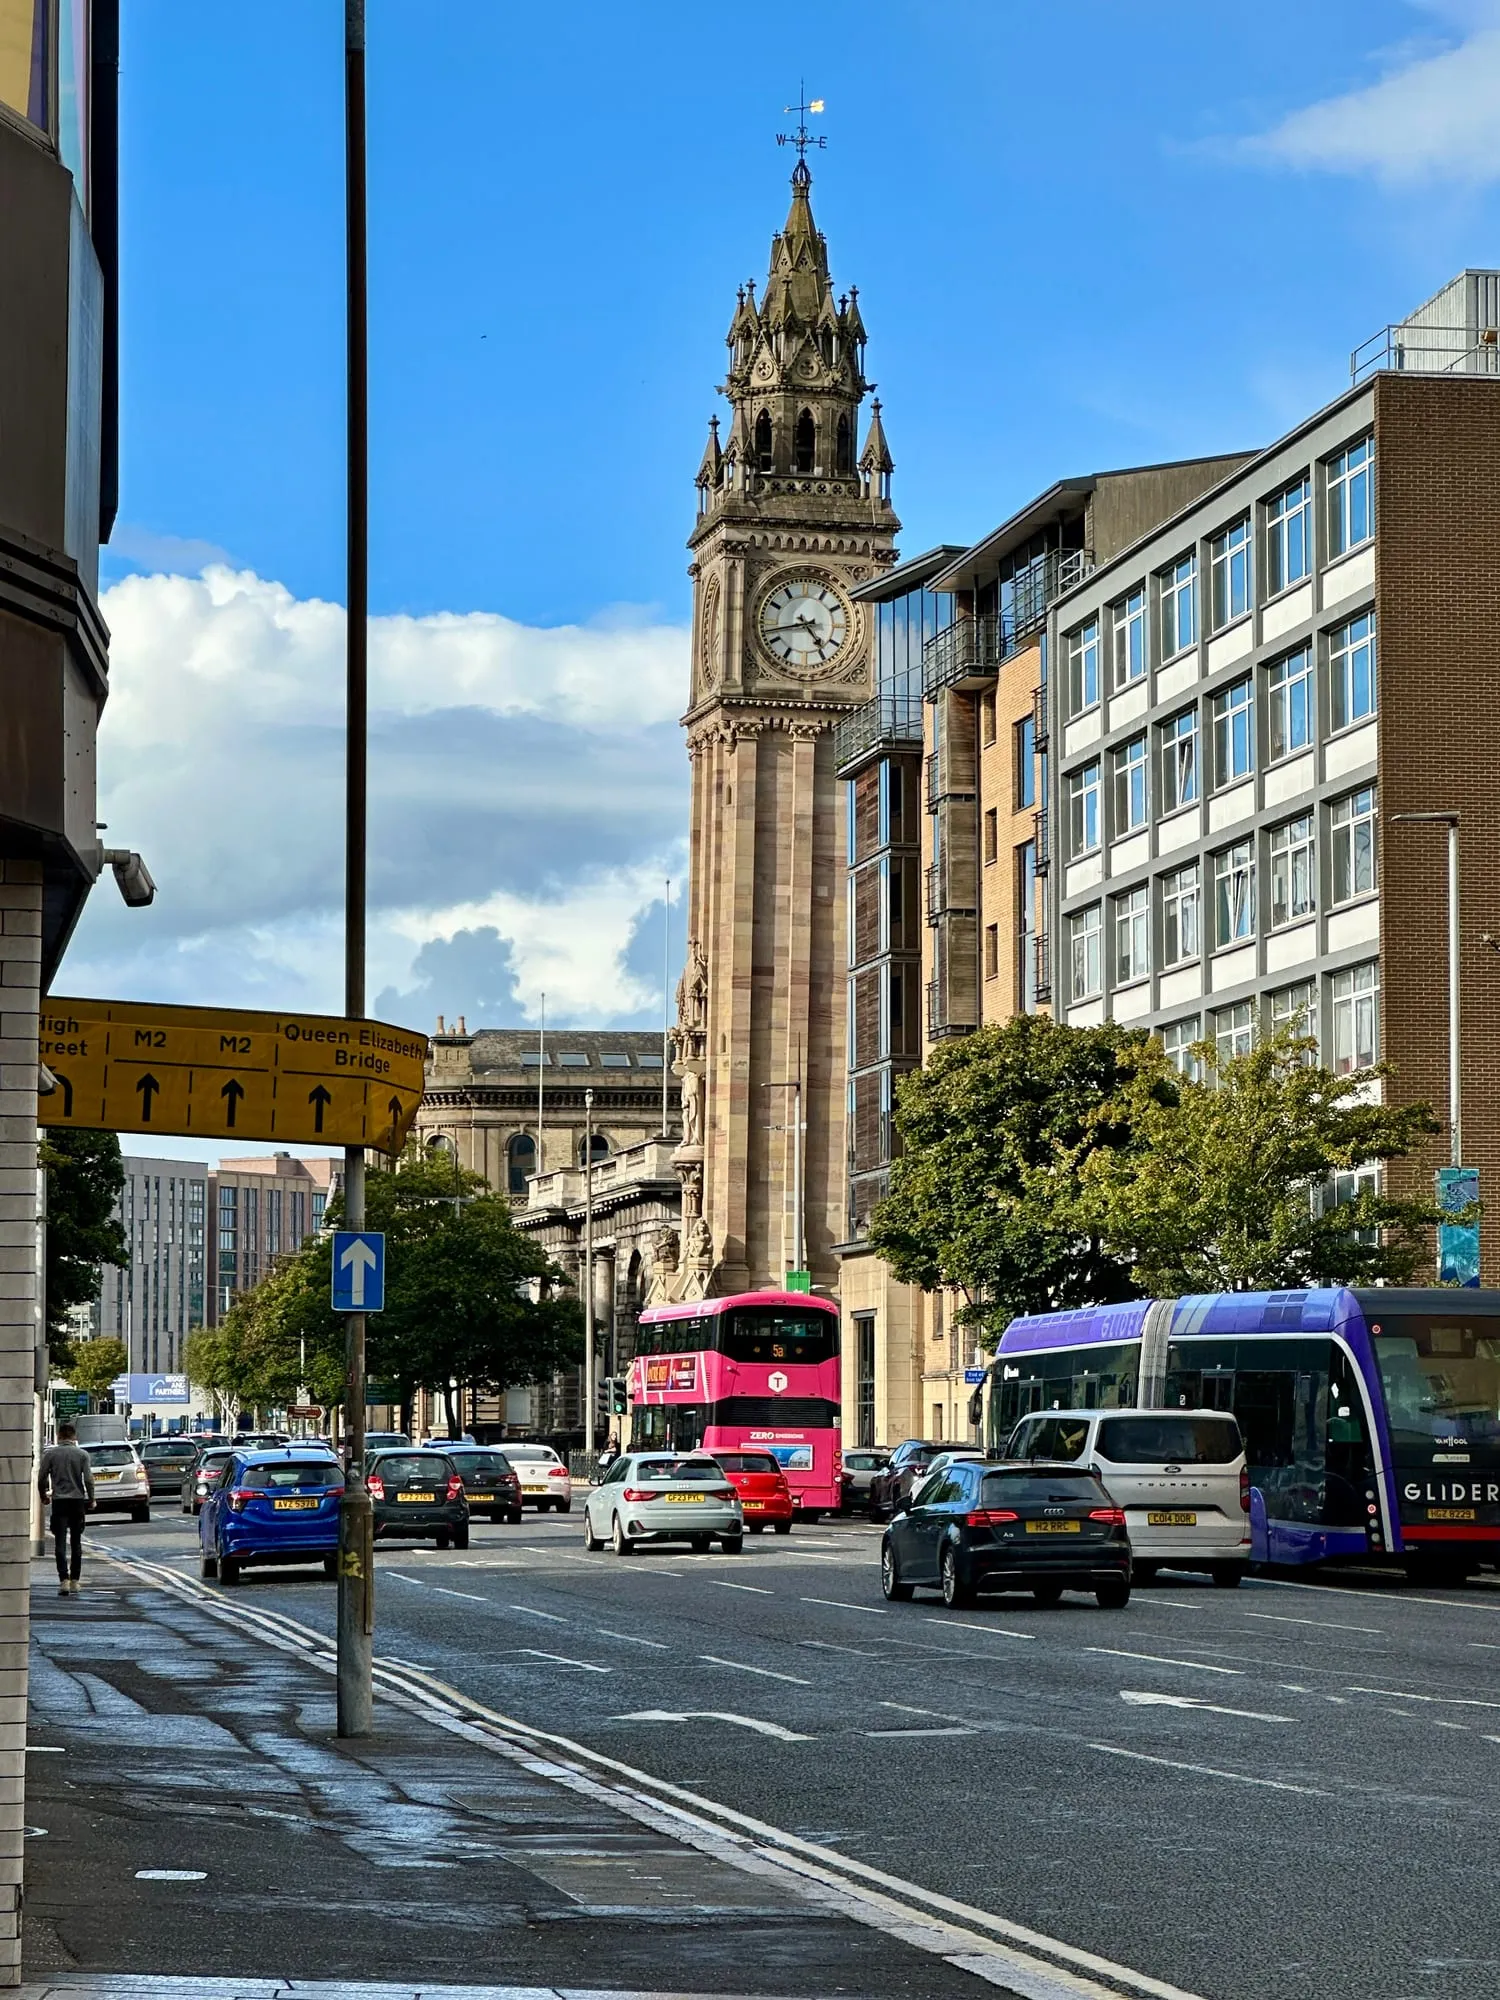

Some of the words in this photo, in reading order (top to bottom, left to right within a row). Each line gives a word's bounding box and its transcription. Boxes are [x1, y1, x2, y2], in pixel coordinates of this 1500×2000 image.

[819, 136, 828, 149] E
[39, 1039, 88, 1056] treet
[134, 1030, 167, 1048] M2
[219, 1035, 252, 1053] M2
[284, 1023, 350, 1044] Queen
[359, 1029, 424, 1061] Elizabeth
[335, 1049, 391, 1074] Bridge
[772, 1344, 784, 1358] 5a
[773, 1377, 783, 1388] T
[750, 1432, 775, 1440] ZERO
[1404, 1483, 1500, 1502] GLIDER
[1035, 1521, 1049, 1531] H2
